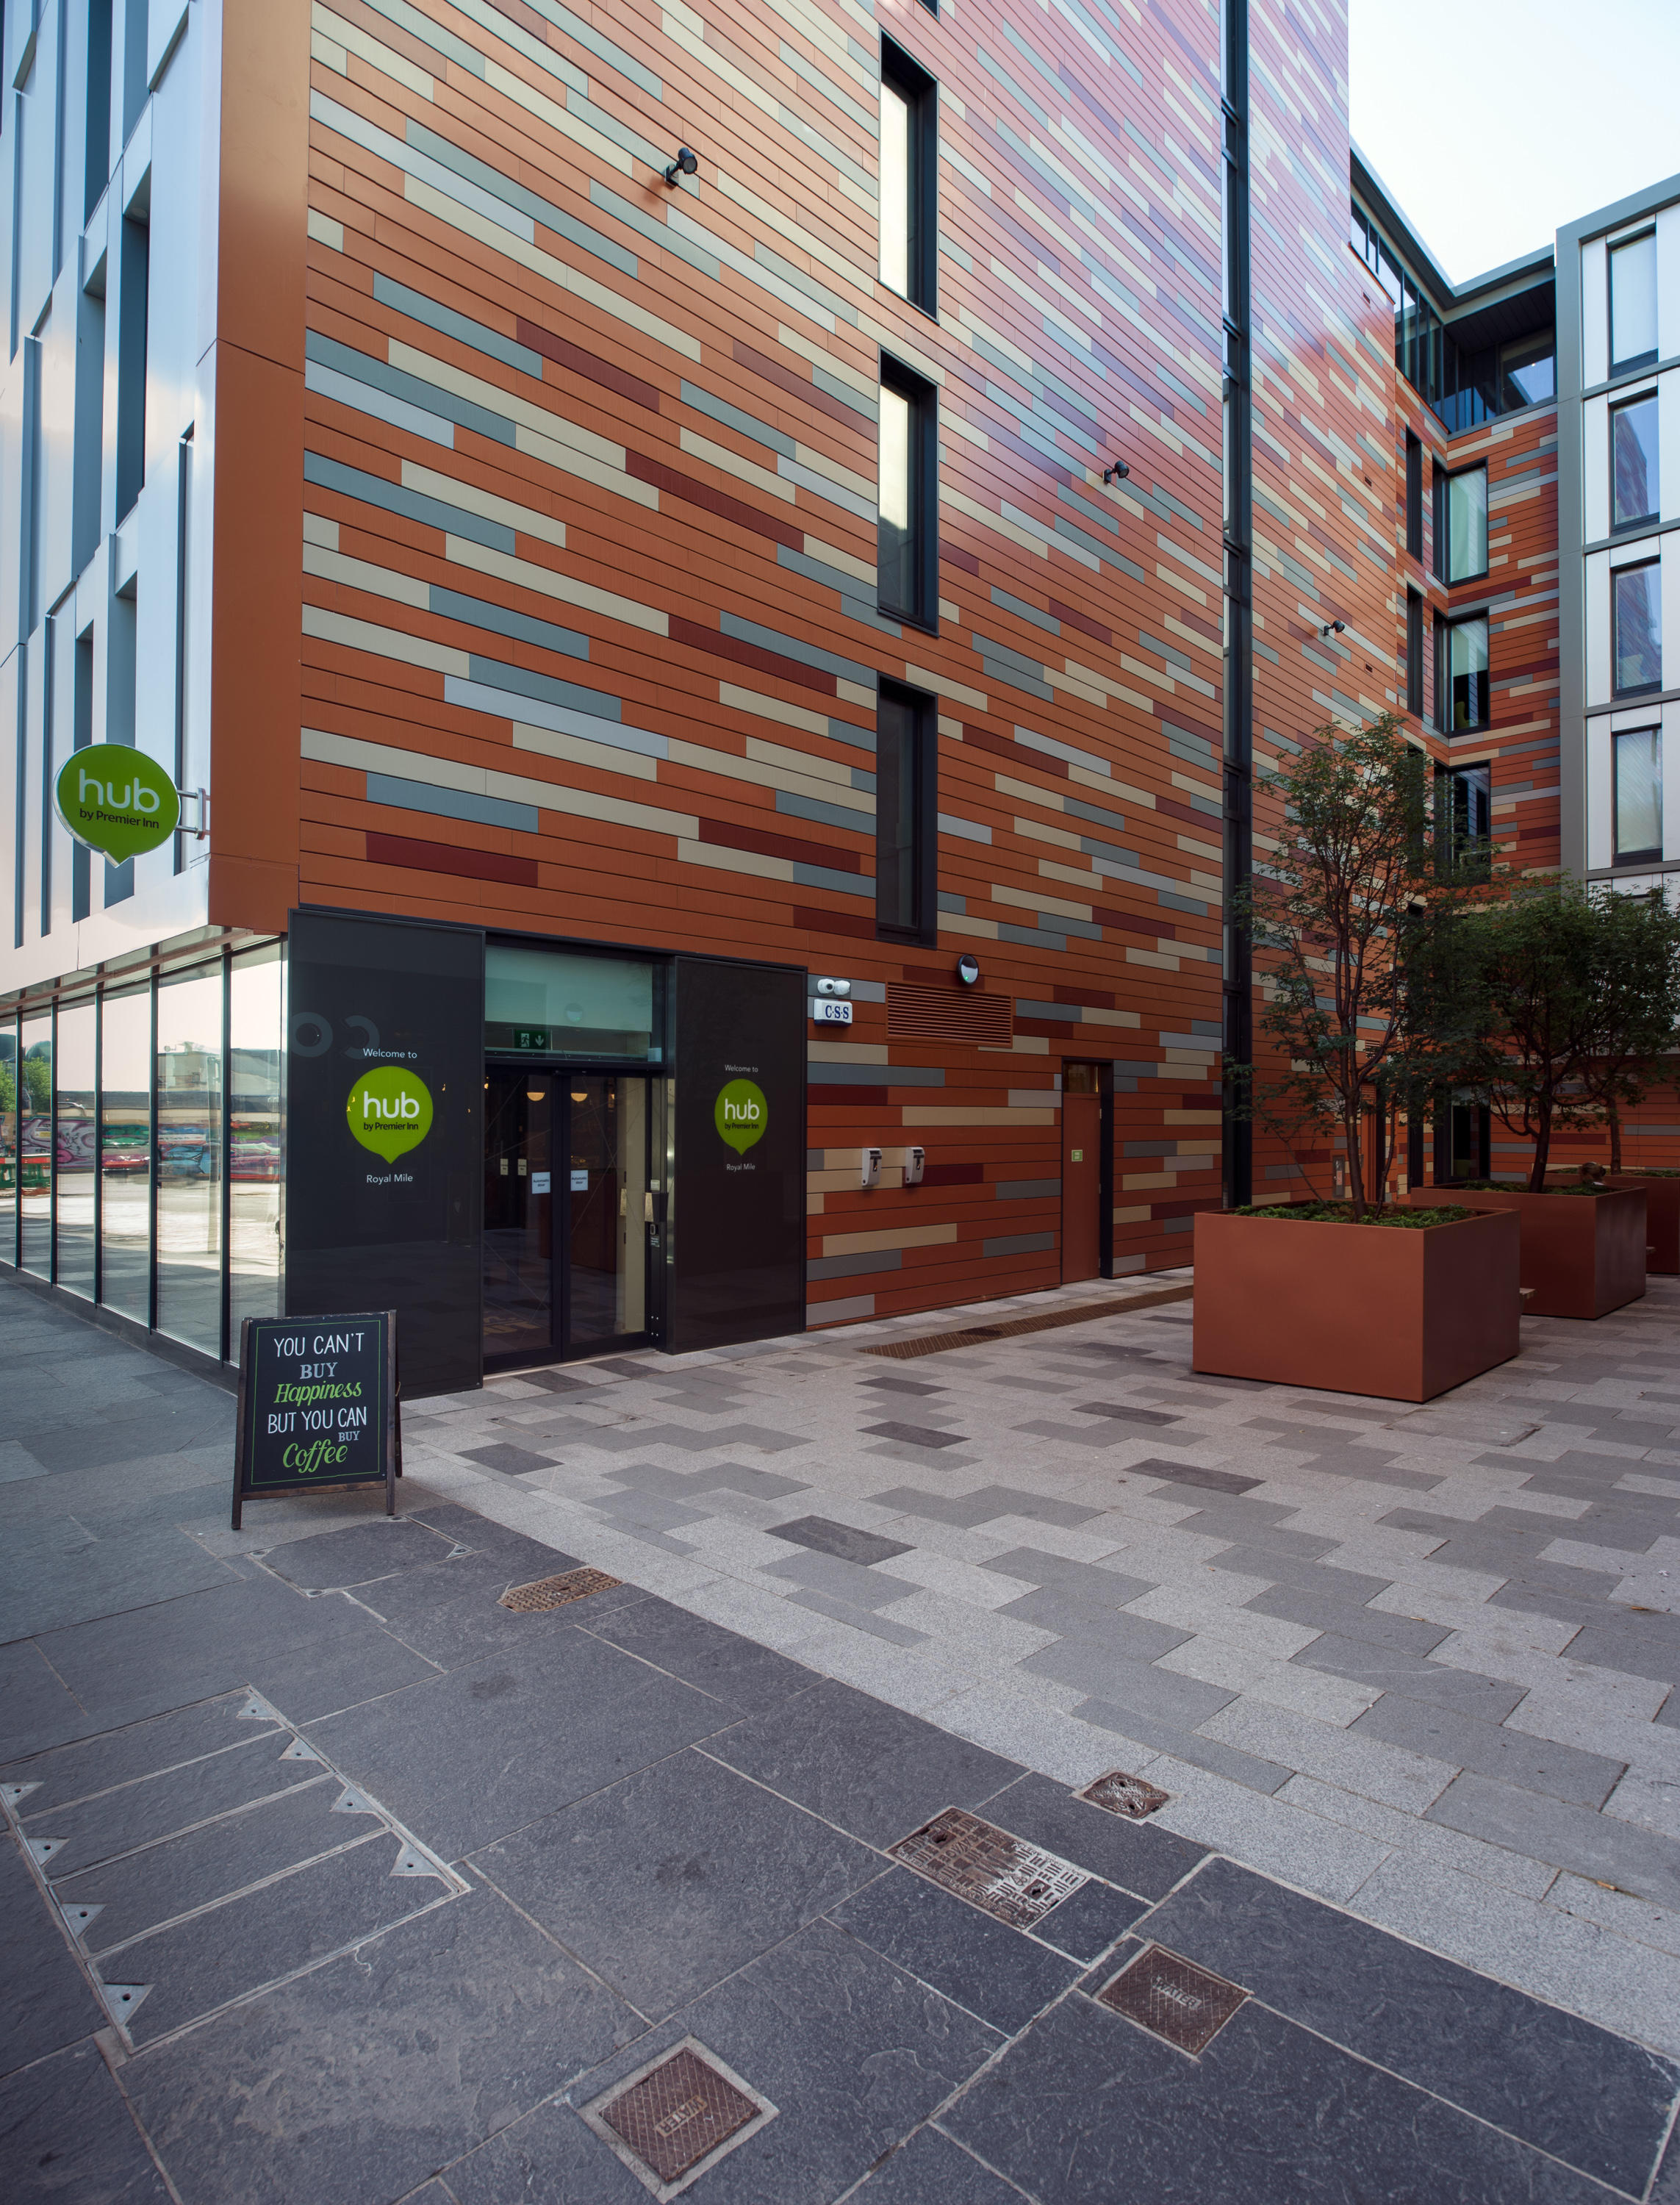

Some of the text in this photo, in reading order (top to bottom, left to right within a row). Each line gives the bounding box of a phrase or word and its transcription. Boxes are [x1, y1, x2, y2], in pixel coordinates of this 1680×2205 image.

[79, 768, 160, 814] hub
[79, 808, 159, 829] by Premier Inn
[362, 1048, 417, 1059] Welcome to
[724, 1064, 751, 1072] Welcome
[363, 1091, 420, 1119] hub
[724, 1098, 760, 1120] hub
[363, 1122, 419, 1132] by Premier Inn
[726, 1163, 755, 1172] Royal Mile
[366, 1173, 414, 1186] Royal Mile
[273, 1332, 365, 1358] YOU CAN'T
[299, 1362, 338, 1380] BUY
[273, 1380, 362, 1407] Happiness
[268, 1406, 367, 1434] BUT YOU CAN
[337, 1430, 361, 1442] BUY
[282, 1438, 348, 1474] Coffee
[658, 2097, 705, 2133] WATER
